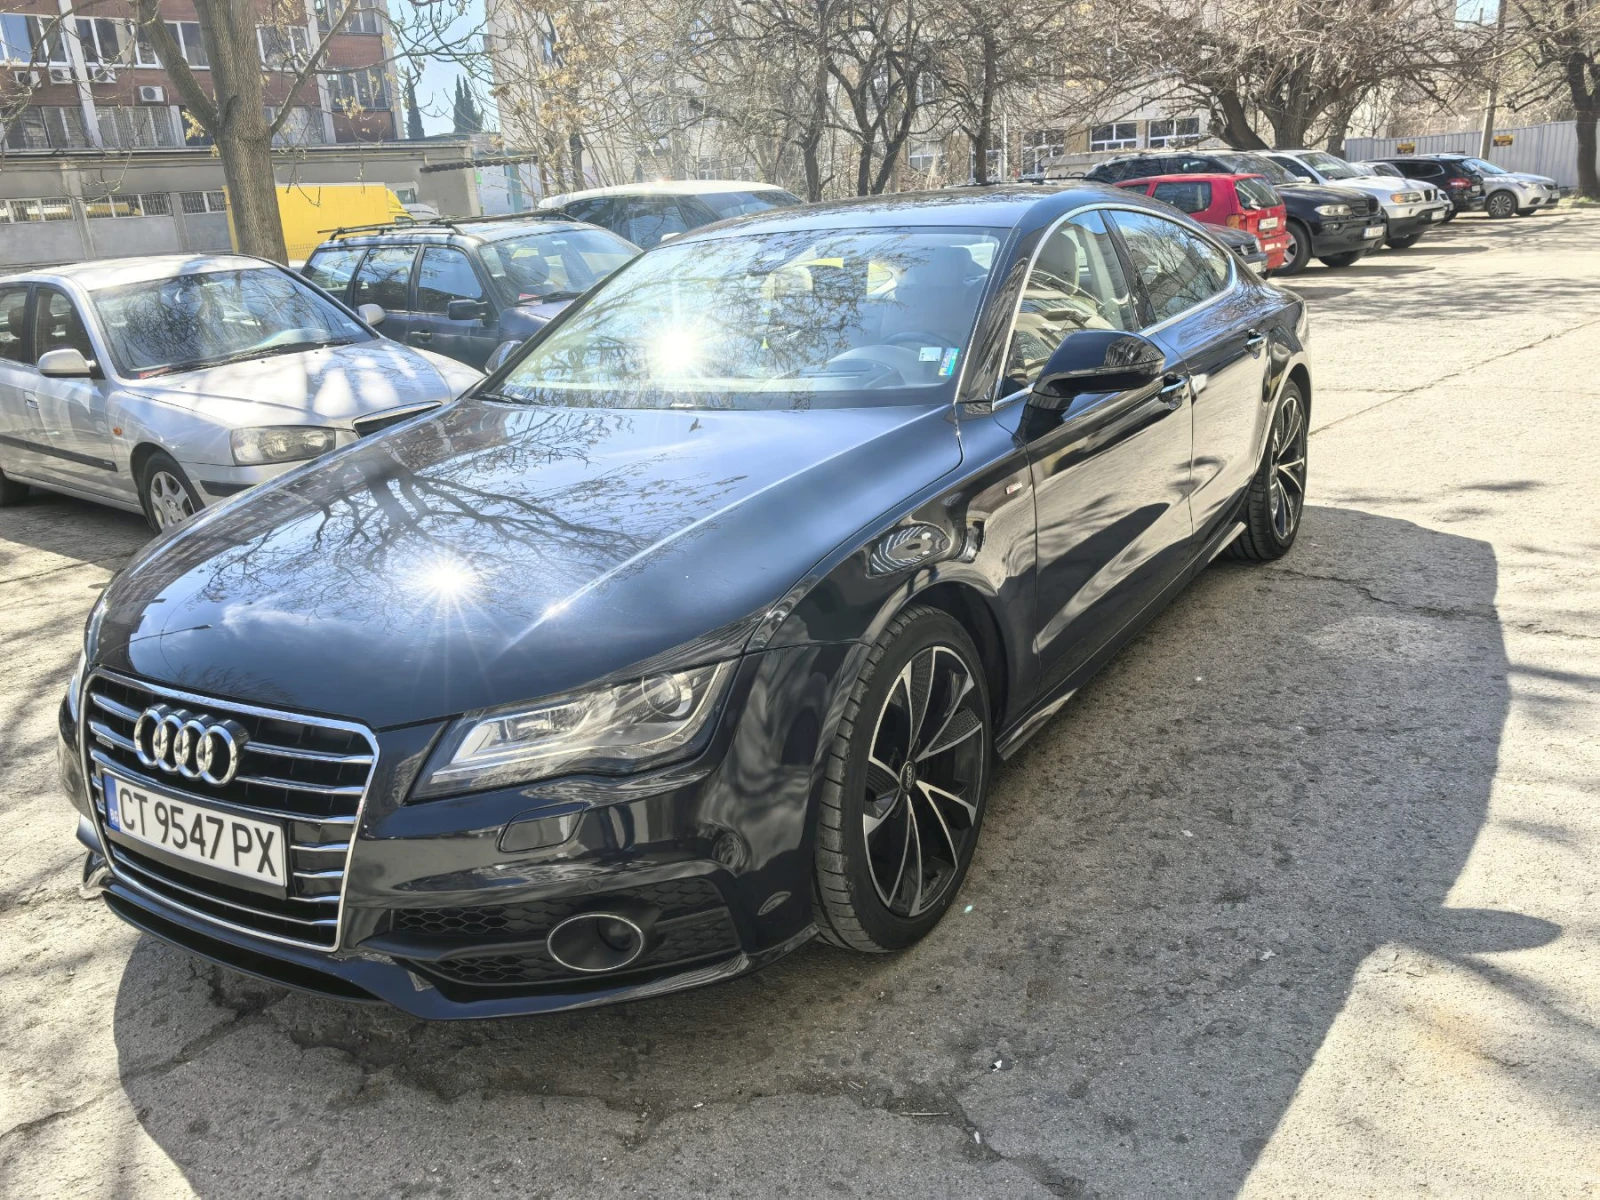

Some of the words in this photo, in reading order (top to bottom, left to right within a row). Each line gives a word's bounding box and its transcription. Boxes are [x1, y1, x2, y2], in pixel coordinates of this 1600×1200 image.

[109, 807, 119, 823] BG
[119, 787, 148, 836] CT
[154, 801, 224, 860] 9547
[231, 821, 277, 877] PX
